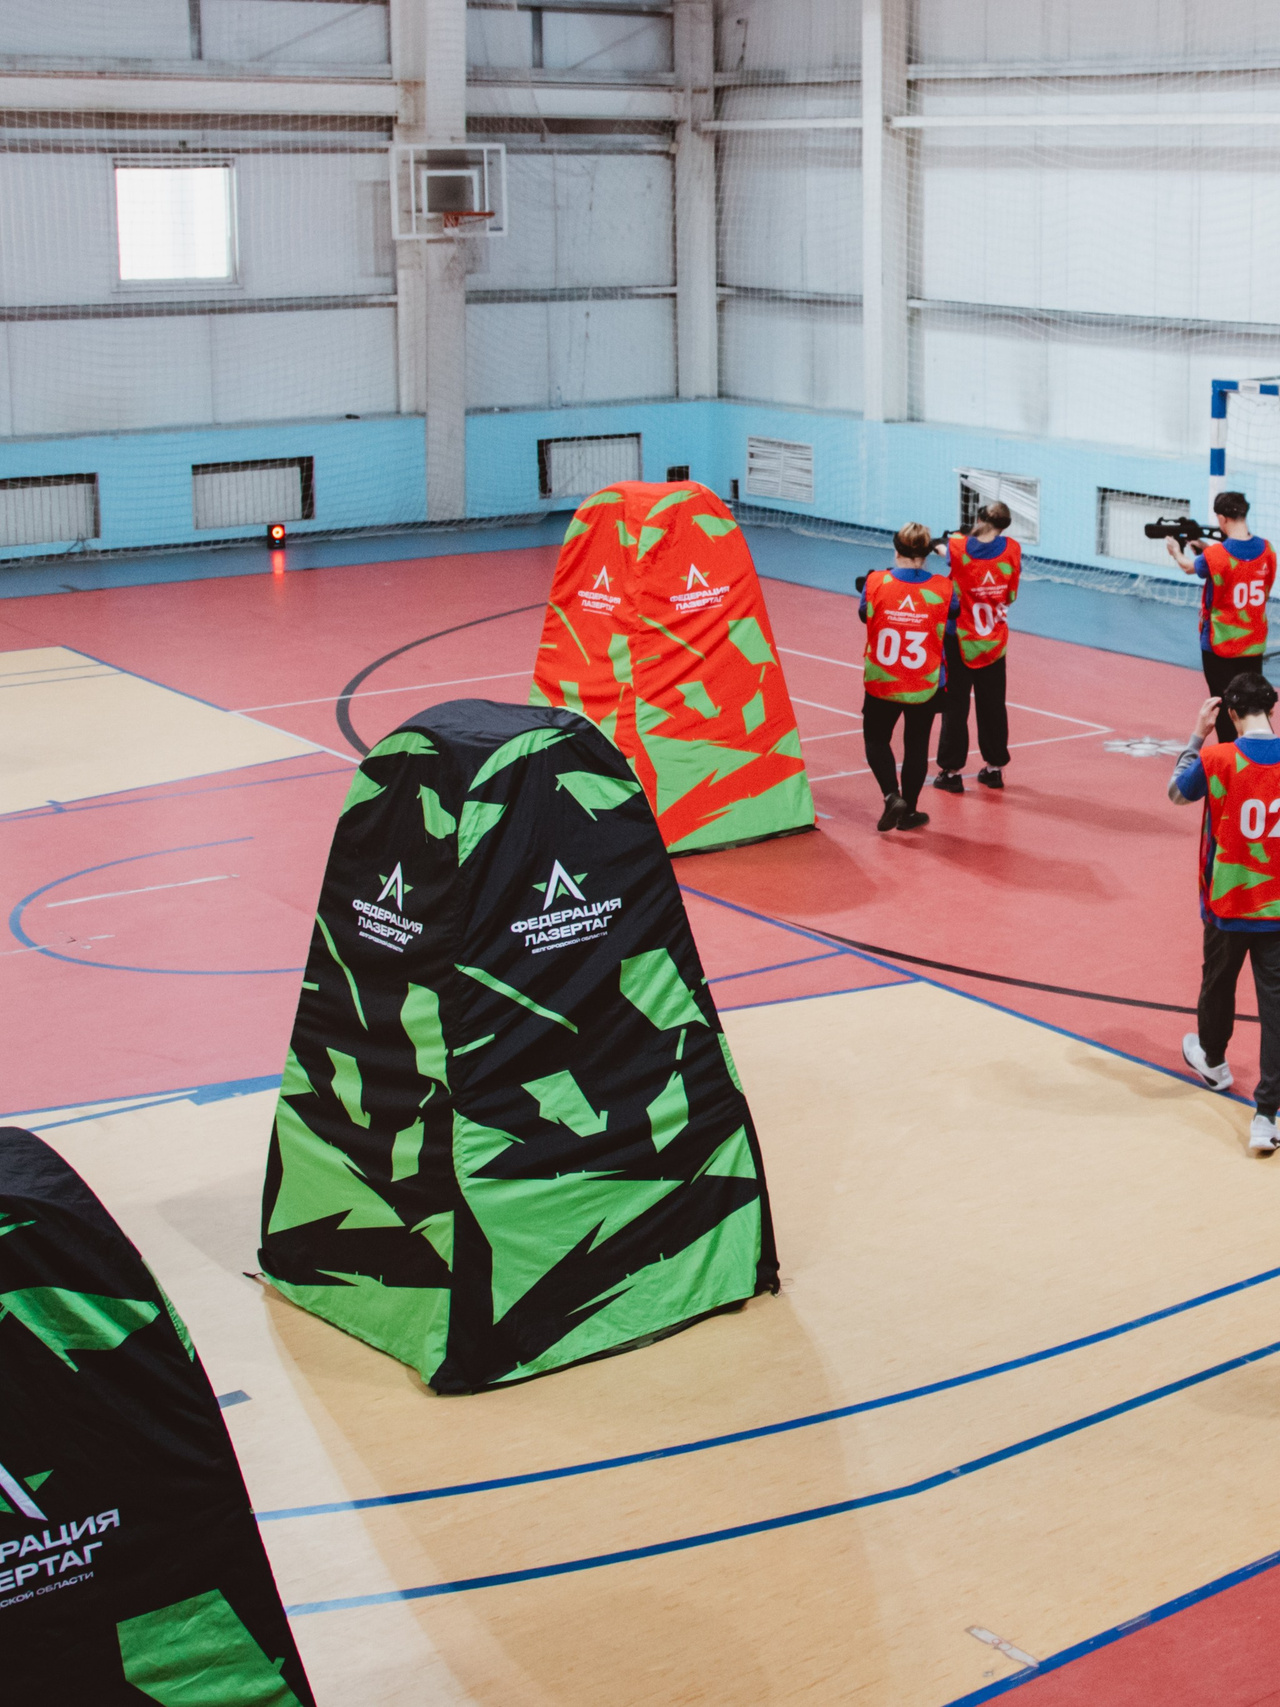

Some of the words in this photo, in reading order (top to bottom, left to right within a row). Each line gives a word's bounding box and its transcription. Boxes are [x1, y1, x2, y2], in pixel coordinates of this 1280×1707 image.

[1233, 580, 1265, 609] 05
[876, 627, 929, 670] 03
[352, 899, 424, 935] ФЕДЕРАЦИЯ
[358, 915, 414, 945] ЛАЗЕРТАГ
[510, 897, 622, 933] ФЕДЕРАЦИЯ
[525, 915, 613, 947] ЛАЗЕРТАГ
[36, 1571, 94, 1596] ОБЛАСТИ
